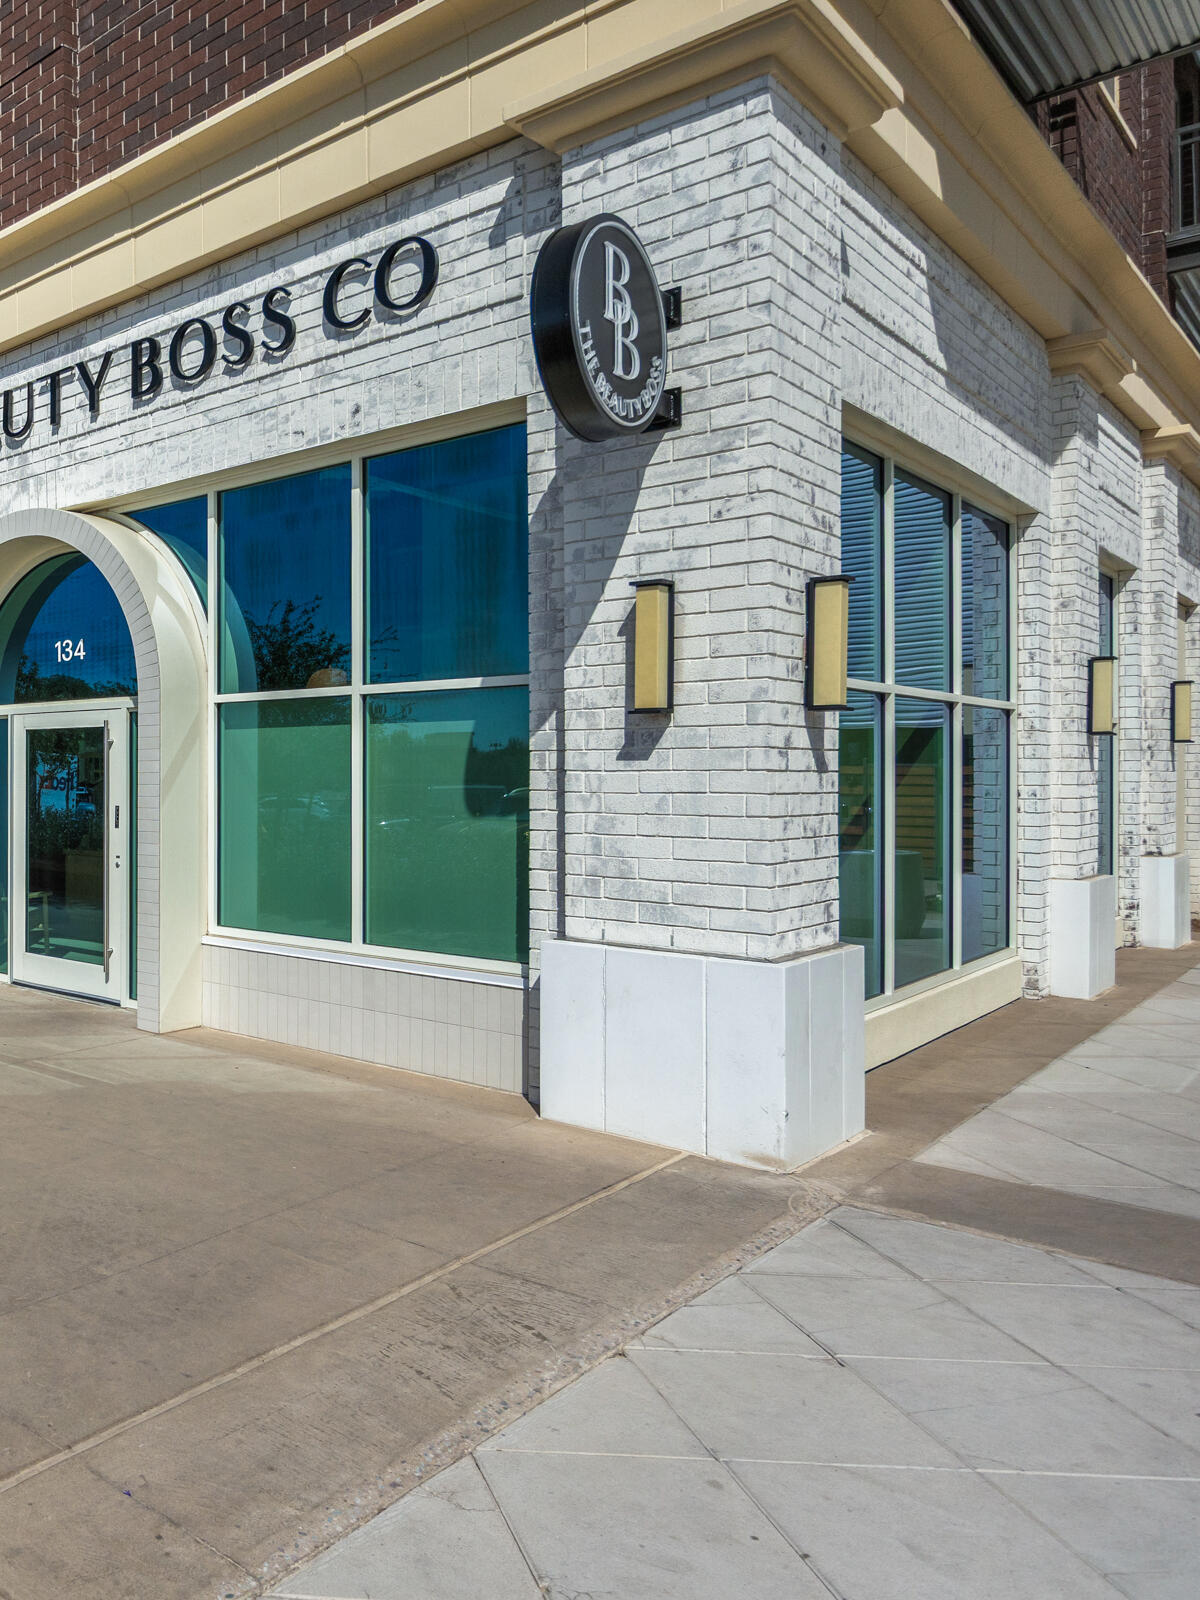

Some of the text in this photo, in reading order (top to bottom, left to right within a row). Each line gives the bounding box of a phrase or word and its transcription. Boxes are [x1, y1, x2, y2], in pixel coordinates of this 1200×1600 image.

[130, 285, 297, 399] BOSS
[323, 235, 440, 330] CO
[579, 319, 664, 419] THE BEAUTY BOSS
[54, 638, 86, 663] 134
